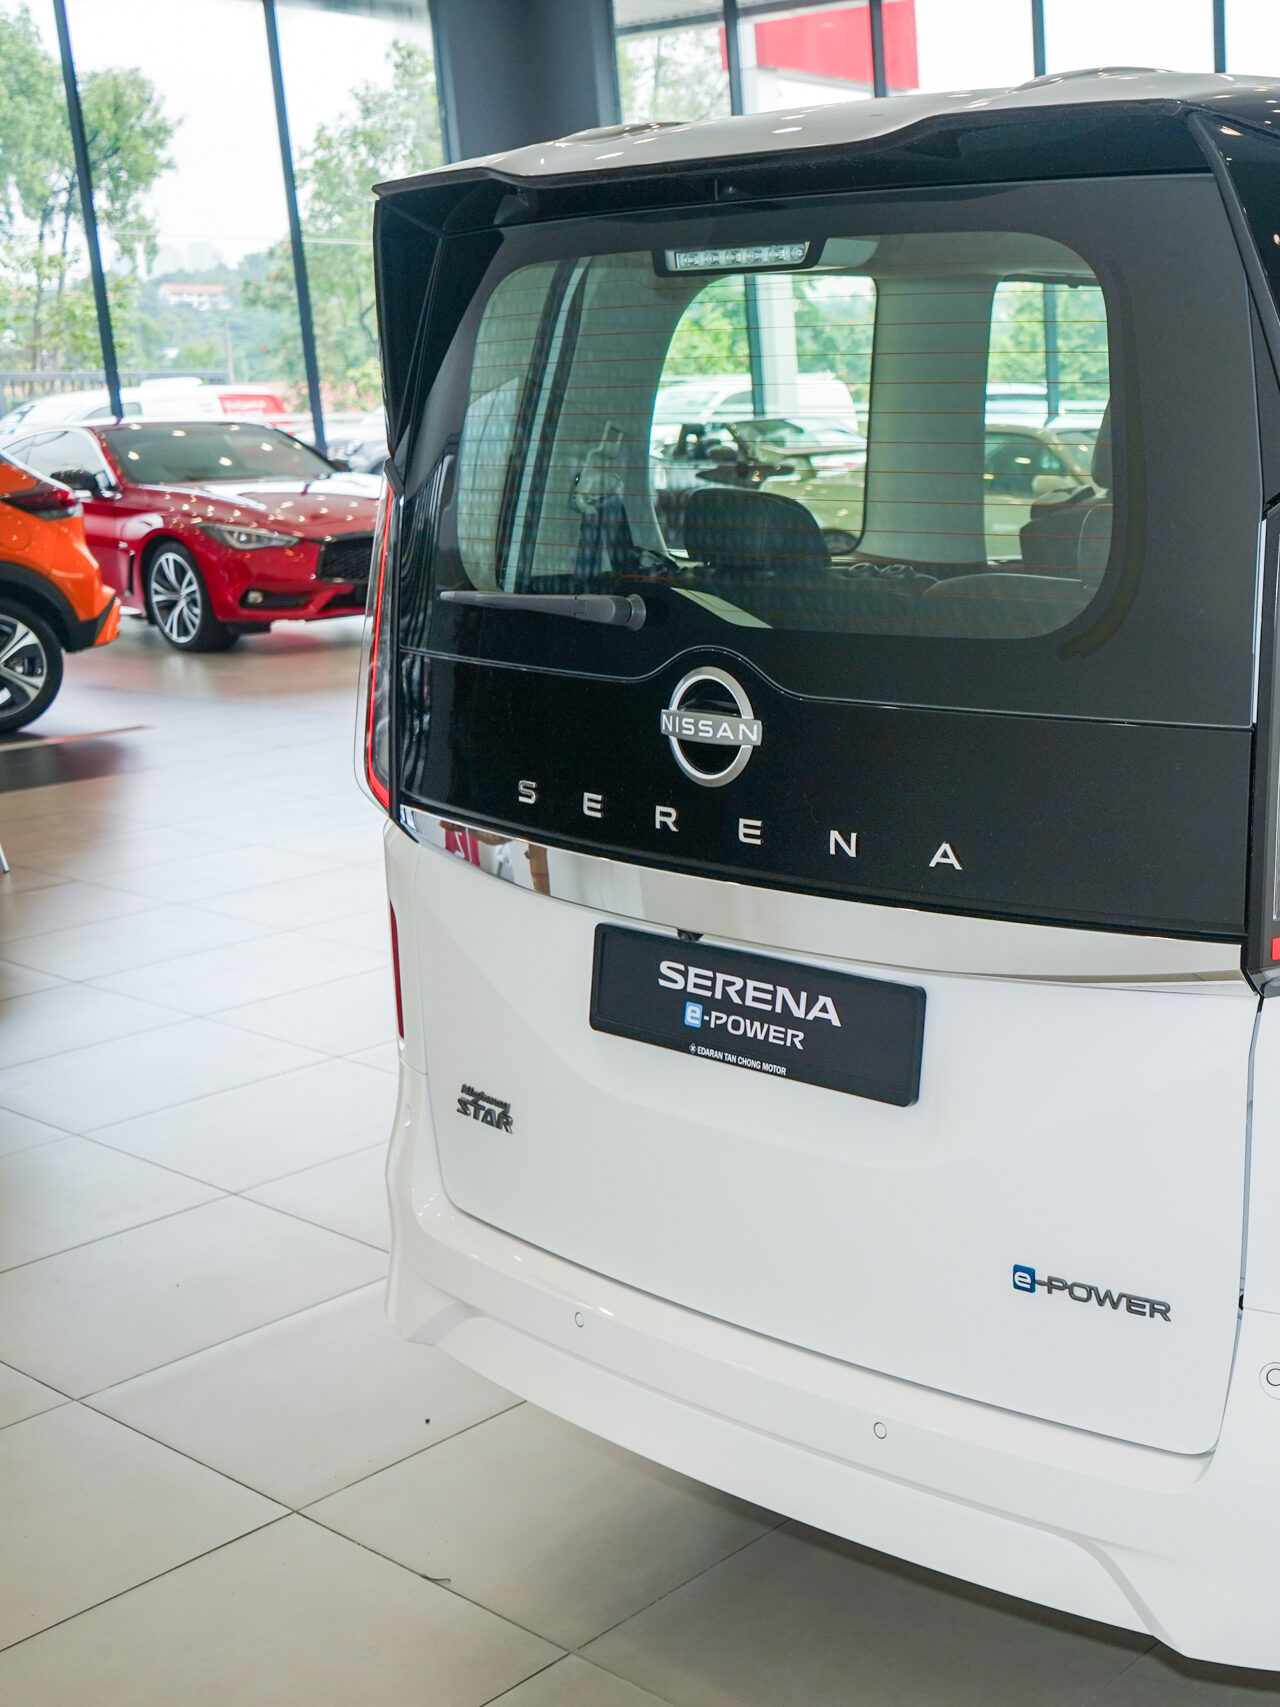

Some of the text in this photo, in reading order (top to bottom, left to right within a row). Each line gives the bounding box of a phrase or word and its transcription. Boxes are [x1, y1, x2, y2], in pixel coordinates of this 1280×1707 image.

[661, 713, 758, 742] NISSAN
[518, 780, 963, 870] SERENA
[658, 960, 842, 1027] SERENA
[683, 1001, 805, 1050] e-POWER
[697, 1045, 787, 1076] EDARAN TAN CHONG MOTOR
[456, 1097, 514, 1134] STAR
[1013, 1264, 1171, 1322] e-POWER
